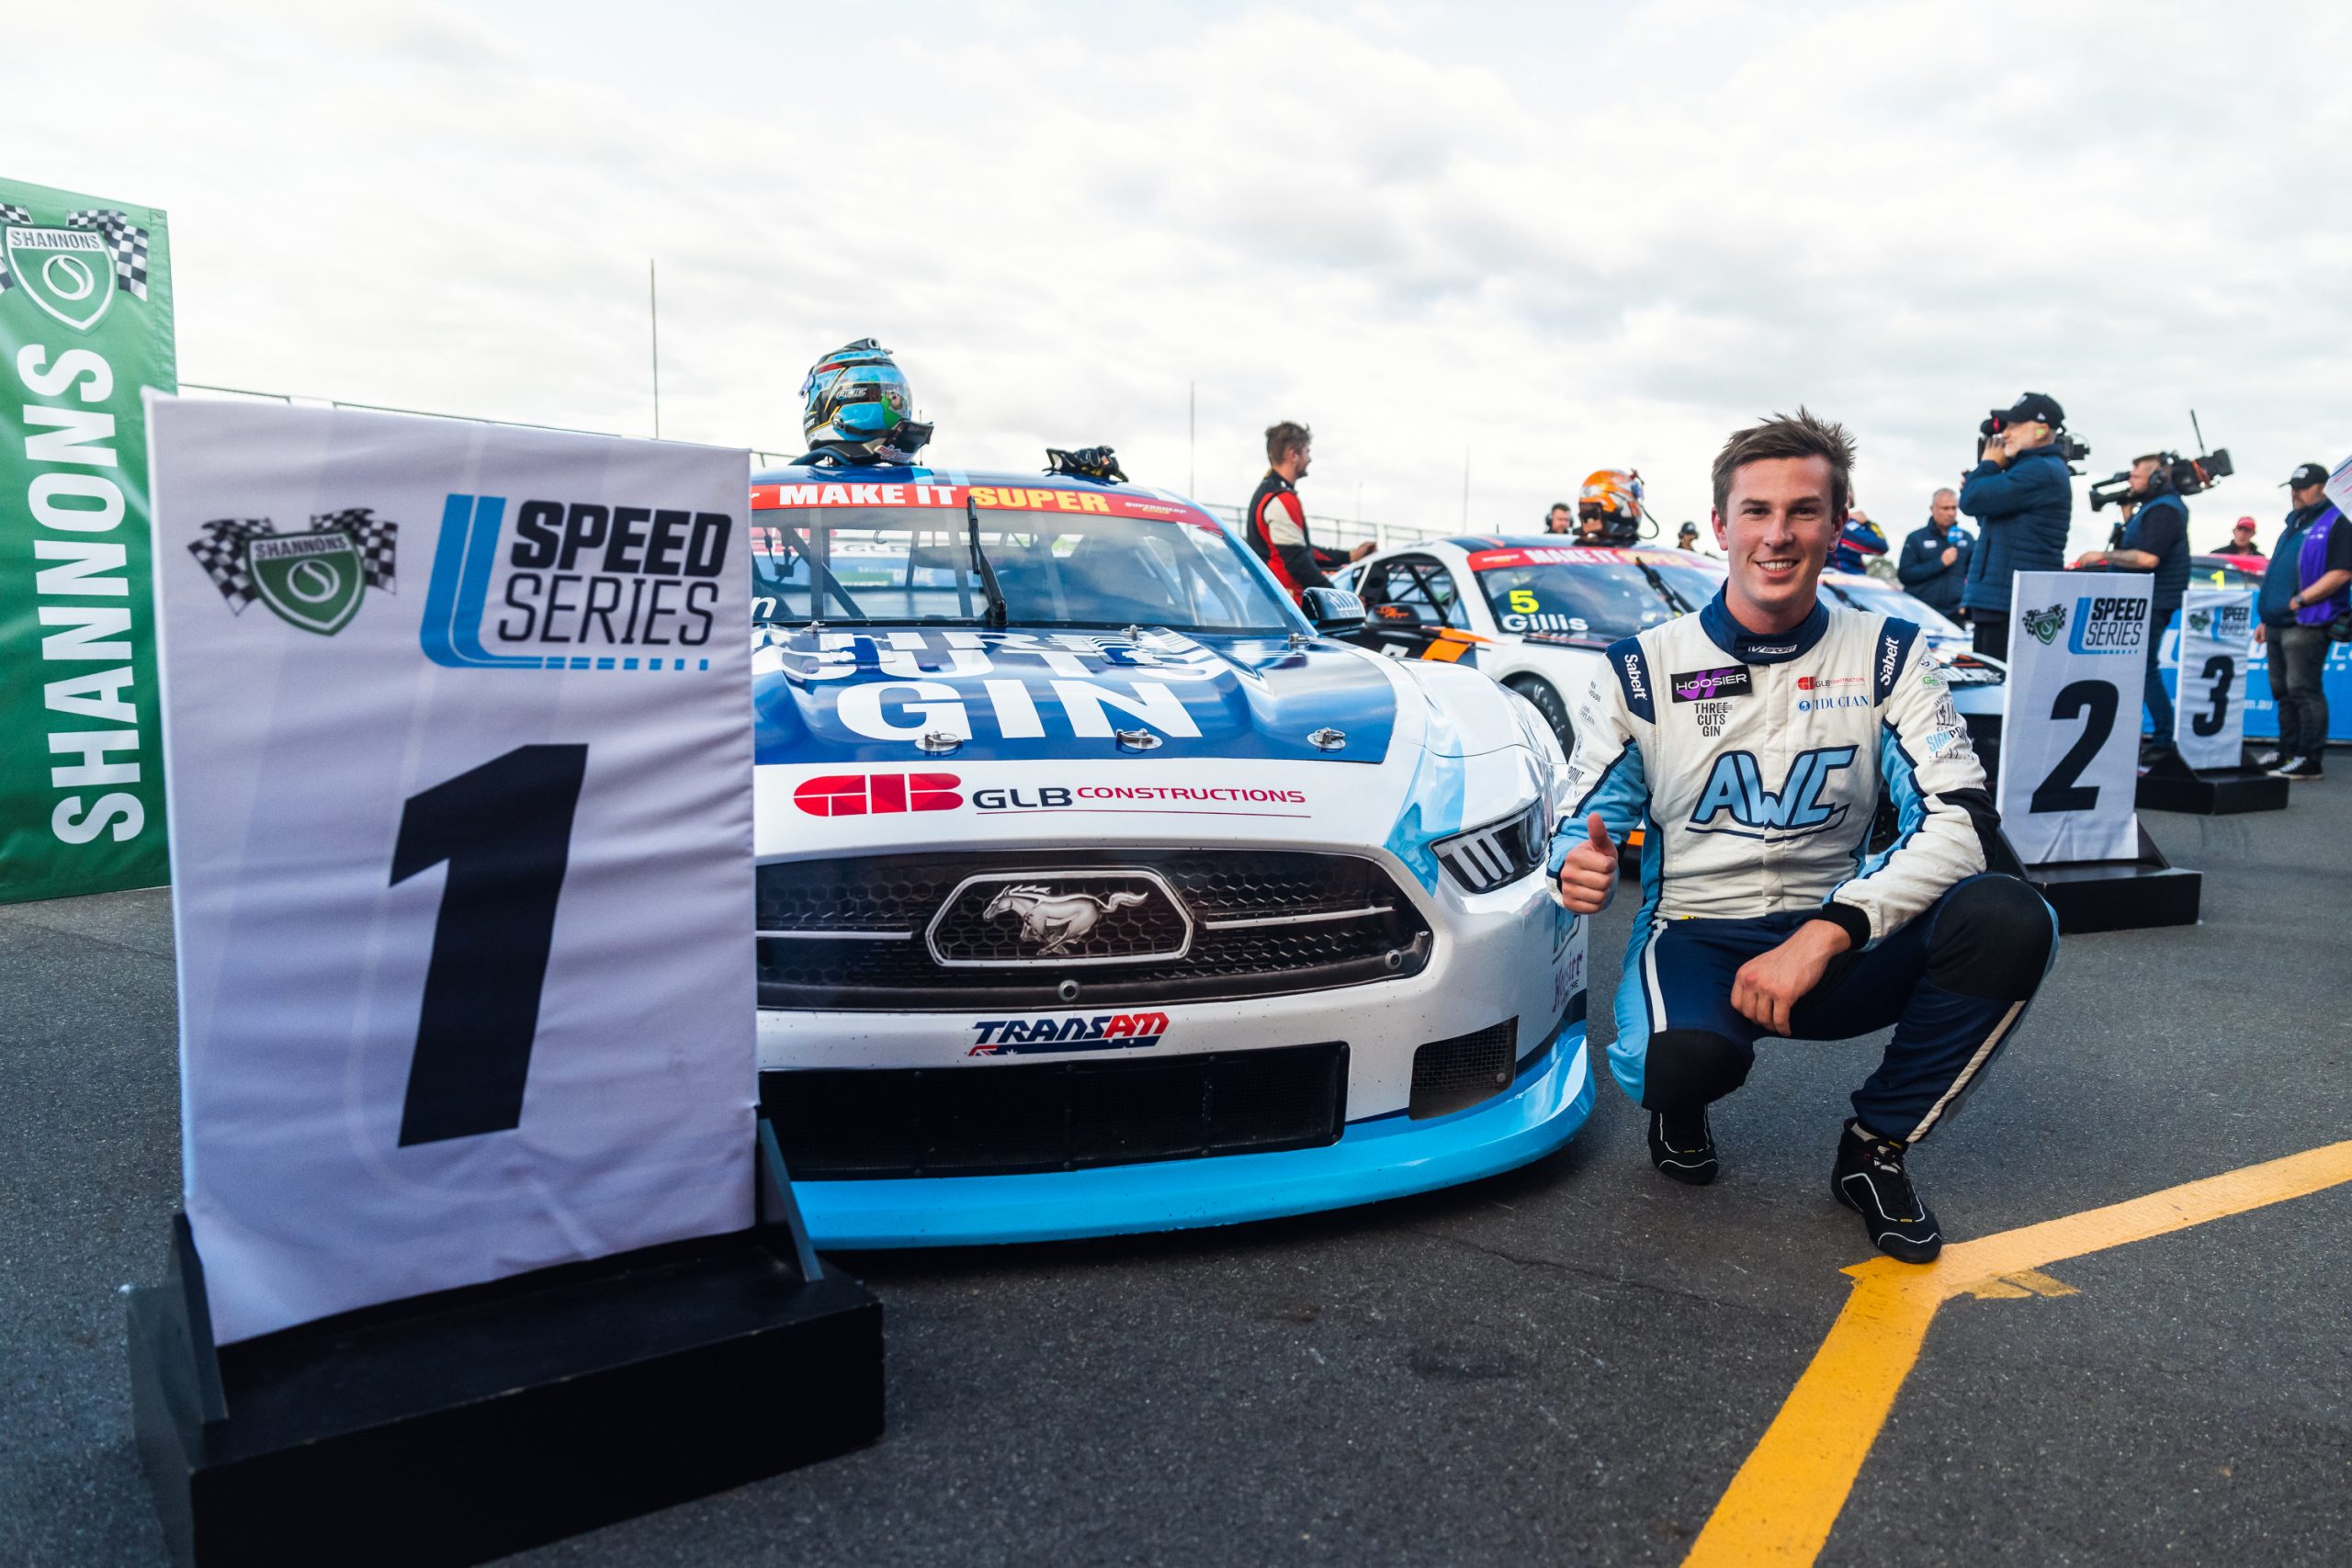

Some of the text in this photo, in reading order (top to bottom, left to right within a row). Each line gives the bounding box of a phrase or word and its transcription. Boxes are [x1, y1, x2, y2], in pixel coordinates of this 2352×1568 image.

[10, 231, 100, 250] SHANNONS
[779, 484, 1110, 513] MAKE IT SUPER
[255, 536, 347, 560] SHANNONS
[511, 499, 732, 578] SPEED
[1524, 549, 1597, 564] MAKE
[2211, 570, 2224, 592] 1
[17, 344, 145, 843] SHANNONS
[1510, 591, 1539, 614] 5
[498, 572, 718, 646] SERIES
[2091, 598, 2147, 621] SPEED
[1501, 614, 1589, 632] Gillis
[2086, 622, 2143, 646] SERIES
[1881, 636, 1899, 686] Sabelt
[1624, 654, 1647, 701] Sabelt
[1676, 673, 1747, 691] HOOSIER
[2192, 655, 2234, 737] 3
[837, 679, 1203, 740] GIN
[1694, 702, 1733, 715] THREE
[1697, 714, 1725, 726] CUTS
[1702, 726, 1721, 737] GIN
[2030, 680, 2119, 813] 2
[973, 786, 1306, 809] GLB CONSTRUCTIONS
[1689, 744, 1860, 831] AWC
[389, 742, 589, 1147] 1
